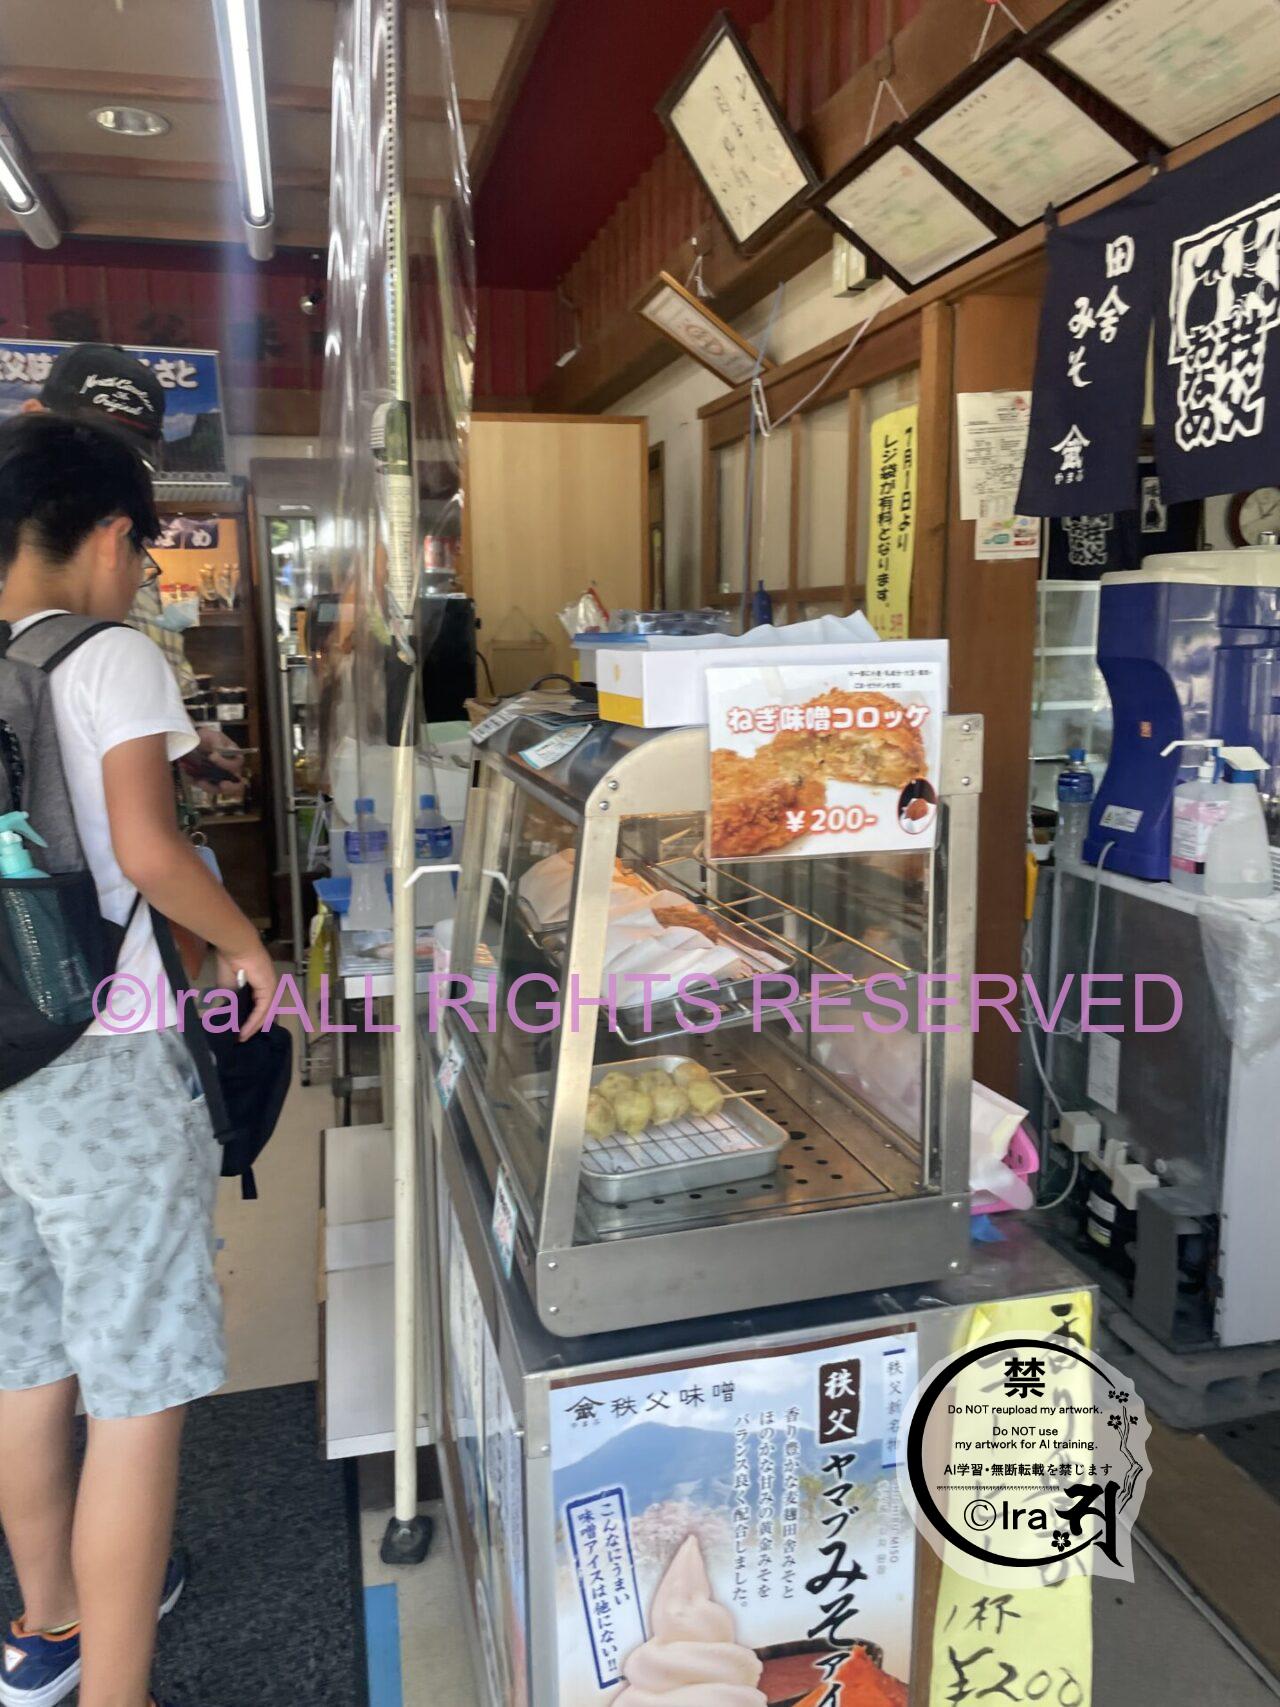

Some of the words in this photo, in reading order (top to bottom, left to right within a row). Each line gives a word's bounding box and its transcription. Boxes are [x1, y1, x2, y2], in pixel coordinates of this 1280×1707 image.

[727, 705, 930, 733] ねぎ味噌コロッケ
[610, 1381, 736, 1419] 秩父味噌
[823, 1368, 857, 1436] 秩父
[600, 1503, 630, 1606] こんなにうまい
